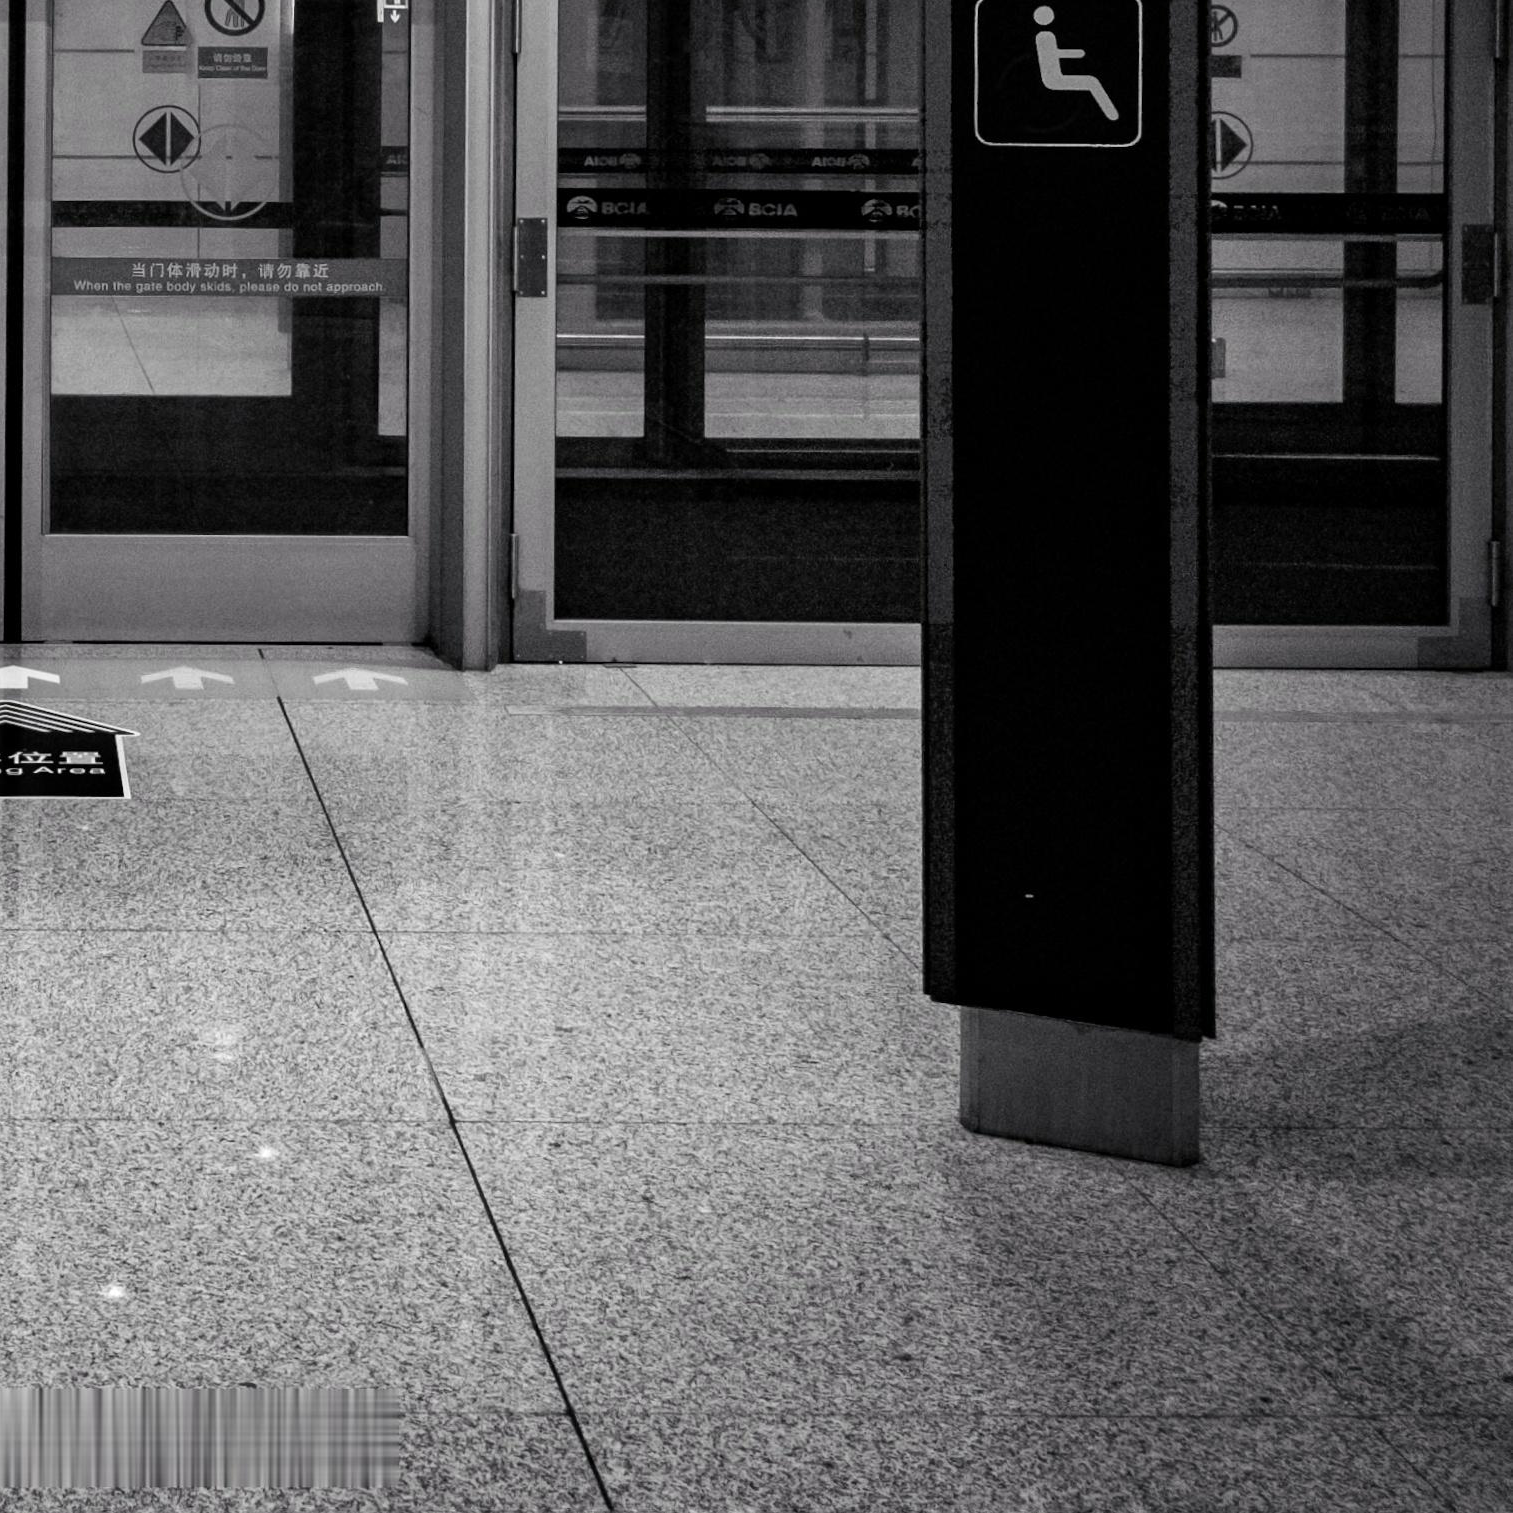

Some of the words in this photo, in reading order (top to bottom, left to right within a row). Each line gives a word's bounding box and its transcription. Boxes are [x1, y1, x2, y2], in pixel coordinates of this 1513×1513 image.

[748, 202, 798, 217] BCIA
[73, 279, 109, 291] When
[112, 280, 132, 291] the
[135, 282, 163, 294] gate
[166, 280, 196, 294] body
[239, 280, 280, 294] please
[283, 280, 299, 292] do
[303, 281, 322, 292] not
[33, 766, 106, 776] Area
